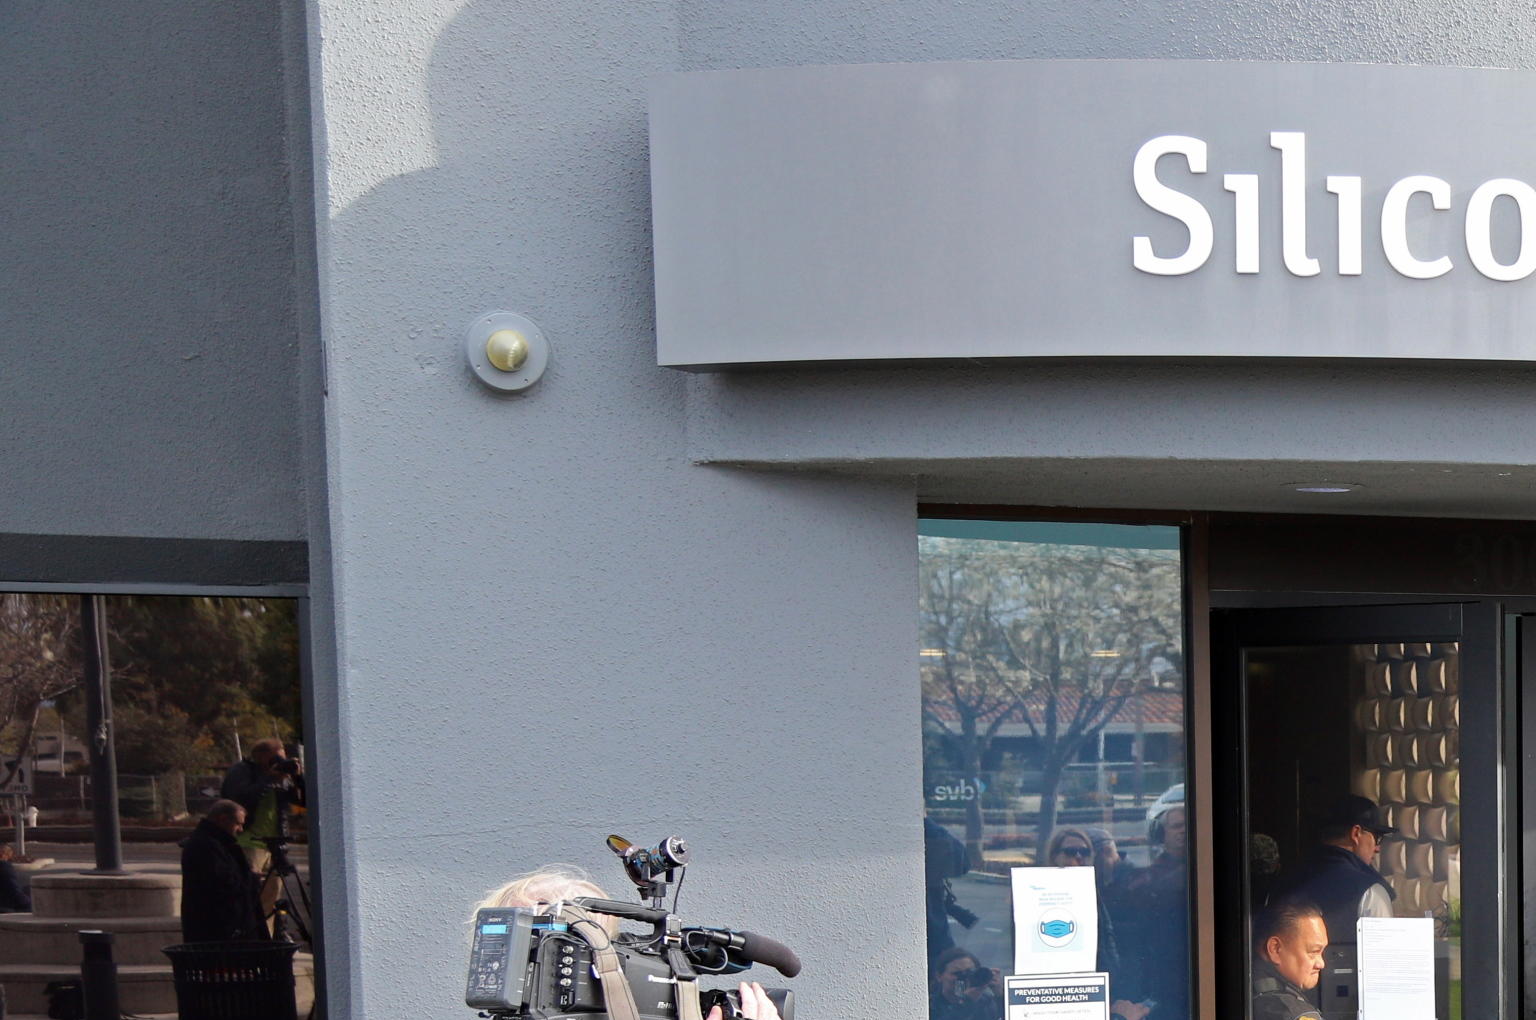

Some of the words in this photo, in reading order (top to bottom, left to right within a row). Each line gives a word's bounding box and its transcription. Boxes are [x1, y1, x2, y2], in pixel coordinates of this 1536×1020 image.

[934, 778, 975, 801] svb
[1014, 987, 1063, 996] PREVENTATIVE
[1064, 986, 1100, 994] MEASURES
[1041, 995, 1062, 1003] GOOD
[1062, 994, 1088, 1002] HEALTH
